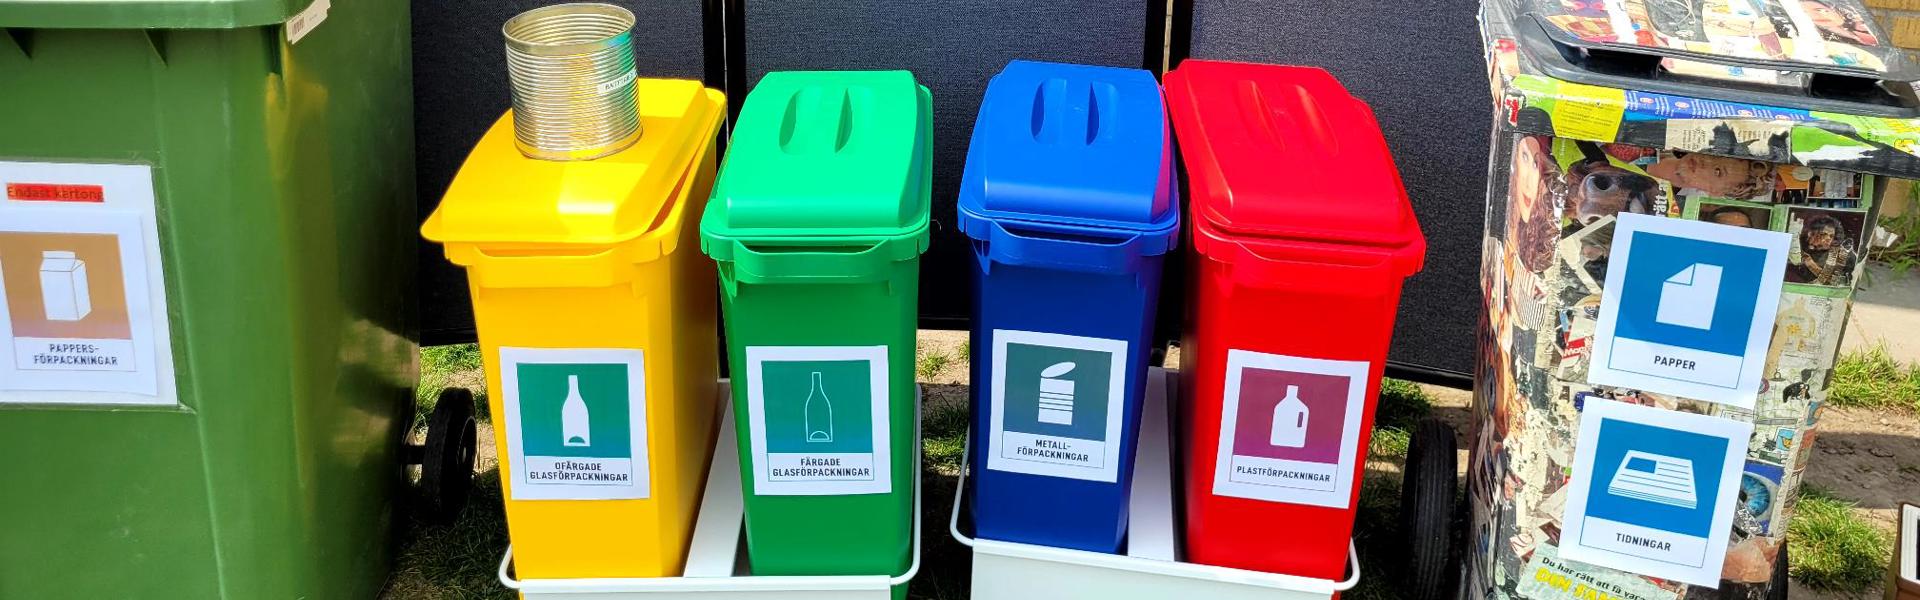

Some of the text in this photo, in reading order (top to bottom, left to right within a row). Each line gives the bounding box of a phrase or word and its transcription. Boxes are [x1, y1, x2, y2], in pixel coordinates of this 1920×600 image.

[7, 186, 104, 203] Endast kartong
[49, 343, 100, 354] PAPPERS-
[33, 353, 119, 366] FÖRPACKNINGAR
[1654, 355, 1696, 371] PAPPER
[1035, 439, 1072, 450] METALL-
[1017, 446, 1089, 462] FÖRPACKNINGAR
[555, 460, 602, 471] OFÄRGADE
[800, 456, 841, 467] FÄRGADE
[530, 470, 628, 482] GLASFÖRPACKNINGAR
[773, 466, 870, 477] GLASFÖRPACKNINGAR
[1236, 465, 1331, 482] PLASTFÖRPACKNINGAR
[1616, 532, 1671, 552] TIDNINGAR
[1542, 556, 1555, 568] Du
[1557, 563, 1575, 575] har
[1575, 571, 1595, 585] rätt
[1595, 580, 1609, 591] att
